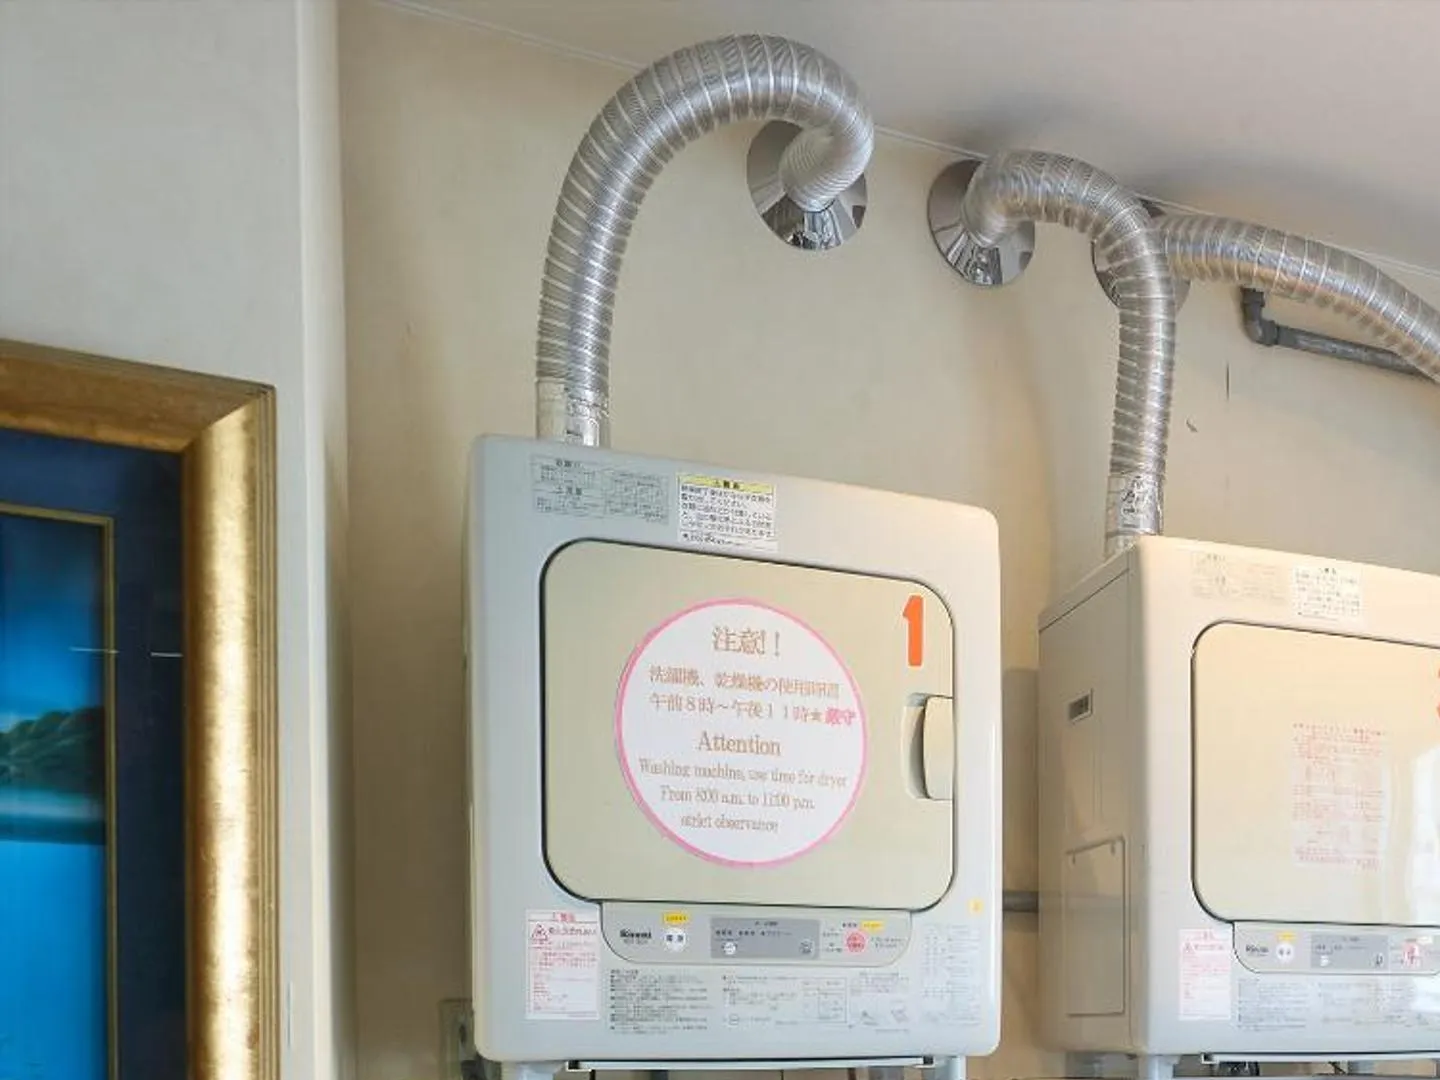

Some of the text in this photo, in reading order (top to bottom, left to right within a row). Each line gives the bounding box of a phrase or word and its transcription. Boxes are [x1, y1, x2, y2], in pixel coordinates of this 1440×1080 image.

[903, 595, 923, 667] 1
[698, 730, 781, 757] Attention
[638, 757, 690, 779] Washing
[772, 768, 795, 784] time
[797, 772, 814, 786] for
[660, 784, 692, 803] From
[748, 790, 760, 806] to
